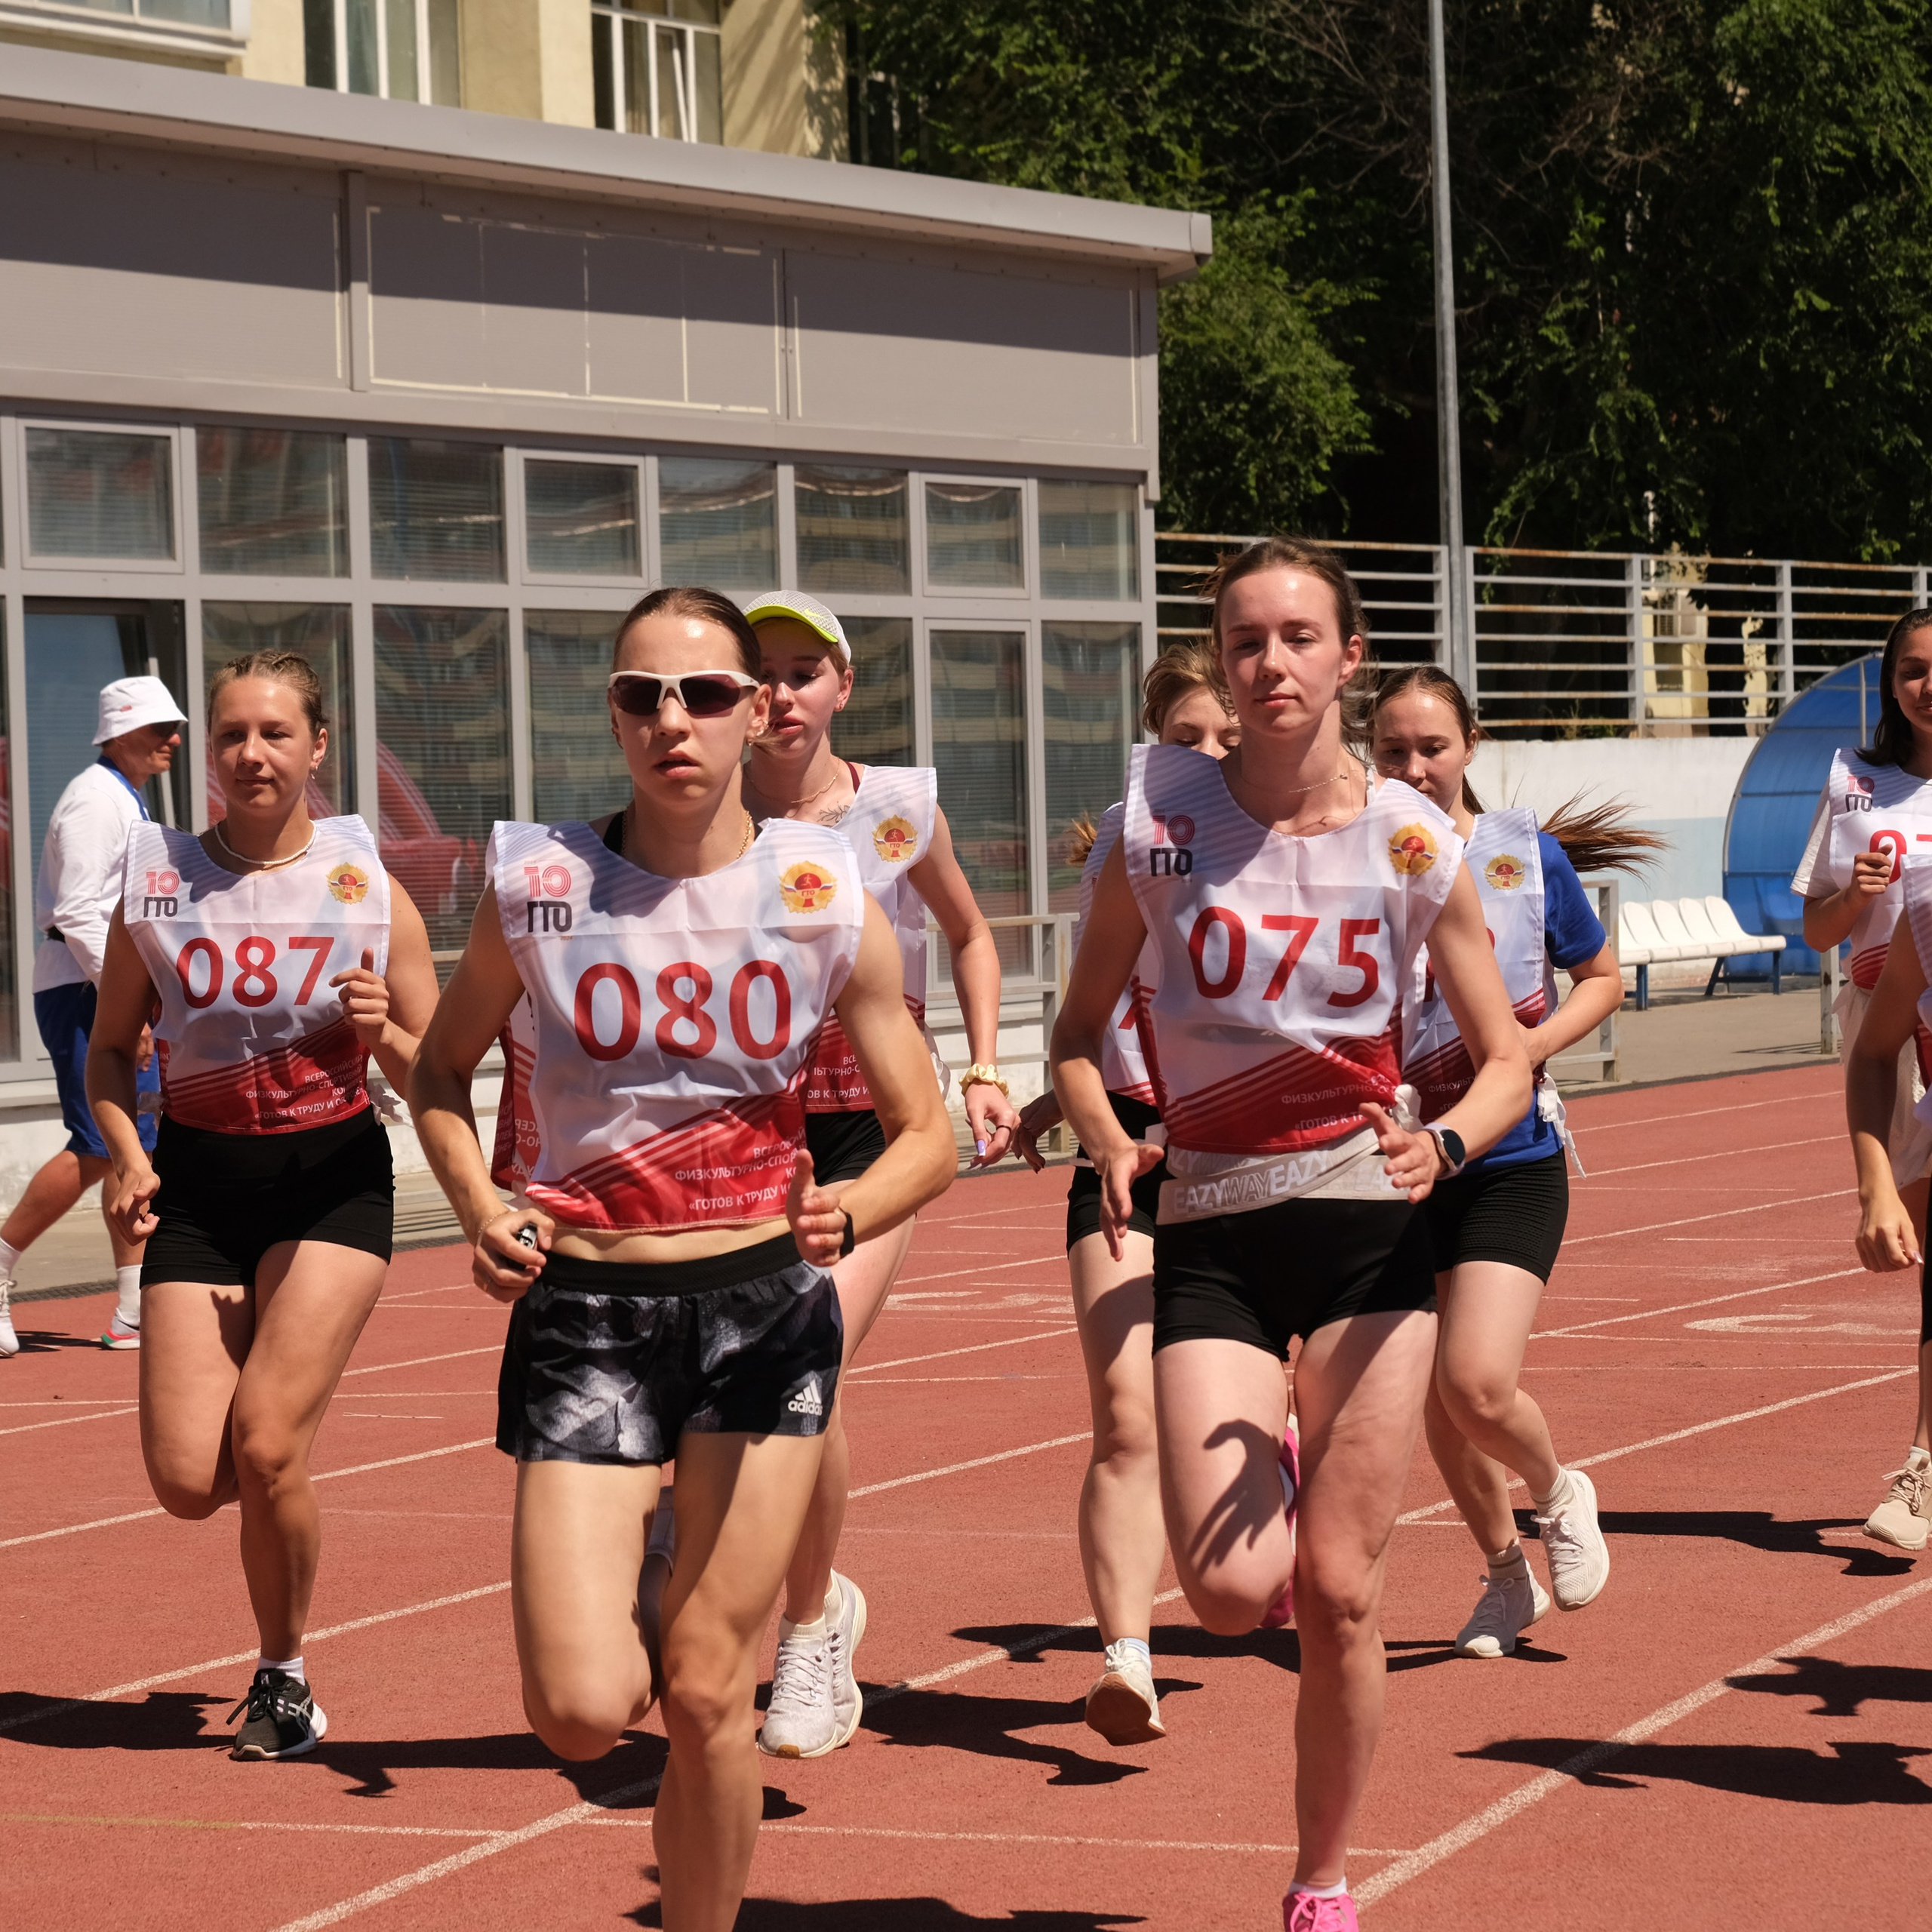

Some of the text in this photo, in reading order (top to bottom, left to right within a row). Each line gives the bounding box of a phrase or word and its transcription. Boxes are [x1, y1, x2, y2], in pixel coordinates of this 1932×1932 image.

[1847, 774, 1875, 794] 10
[1845, 794, 1872, 813] ГТО
[1152, 815, 1195, 845] 10
[1150, 848, 1192, 876] ГТО
[146, 871, 180, 895] 10
[524, 866, 571, 897] 10
[143, 897, 178, 918] ГТО
[527, 900, 572, 933] ГТО
[1188, 906, 1380, 1008] 075
[176, 936, 335, 1009] 087
[574, 959, 792, 1062] 080
[823, 1090, 830, 1099] К
[832, 1087, 861, 1098] ТРУДУ
[289, 1109, 296, 1117] К
[297, 1103, 325, 1115] ТРУДУ
[326, 1101, 334, 1109] И
[689, 1196, 734, 1211] «ГОТОВ
[737, 1195, 744, 1206] К
[745, 1186, 778, 1203] ТРУДУ
[780, 1184, 786, 1194] И
[787, 1400, 823, 1416] adidas
